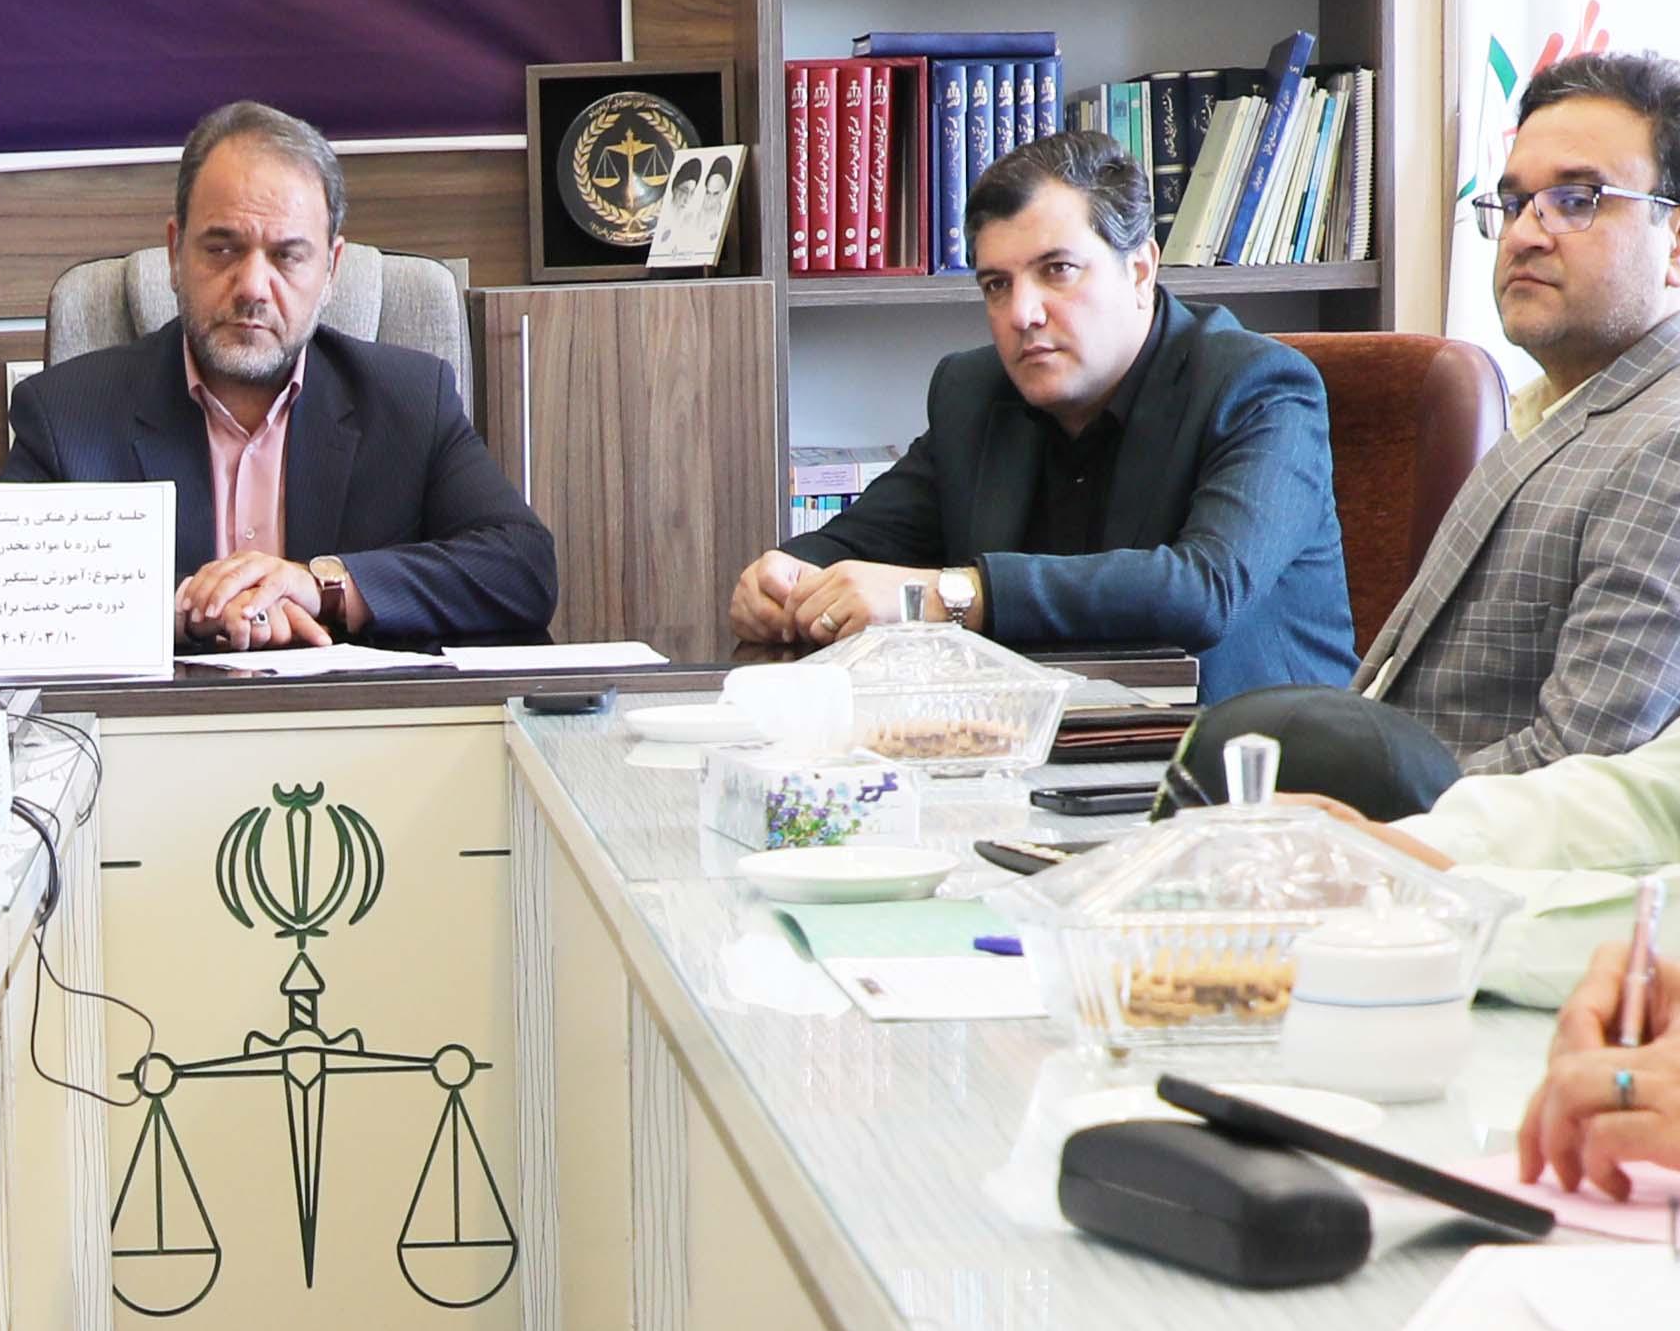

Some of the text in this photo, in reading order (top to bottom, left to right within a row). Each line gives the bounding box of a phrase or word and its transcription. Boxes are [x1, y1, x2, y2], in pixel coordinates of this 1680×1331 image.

[33, 512, 79, 527] فرهنگی
[83, 511, 113, 522] کمیته
[116, 510, 147, 521] جلسه
[34, 540, 60, 553] مواد
[63, 540, 72, 551] با
[75, 540, 112, 554] مبارزه
[42, 568, 86, 585] آموزش
[137, 569, 147, 580] با
[22, 600, 60, 614] خدمت
[64, 601, 94, 614] ضمن
[96, 599, 126, 613] دوره
